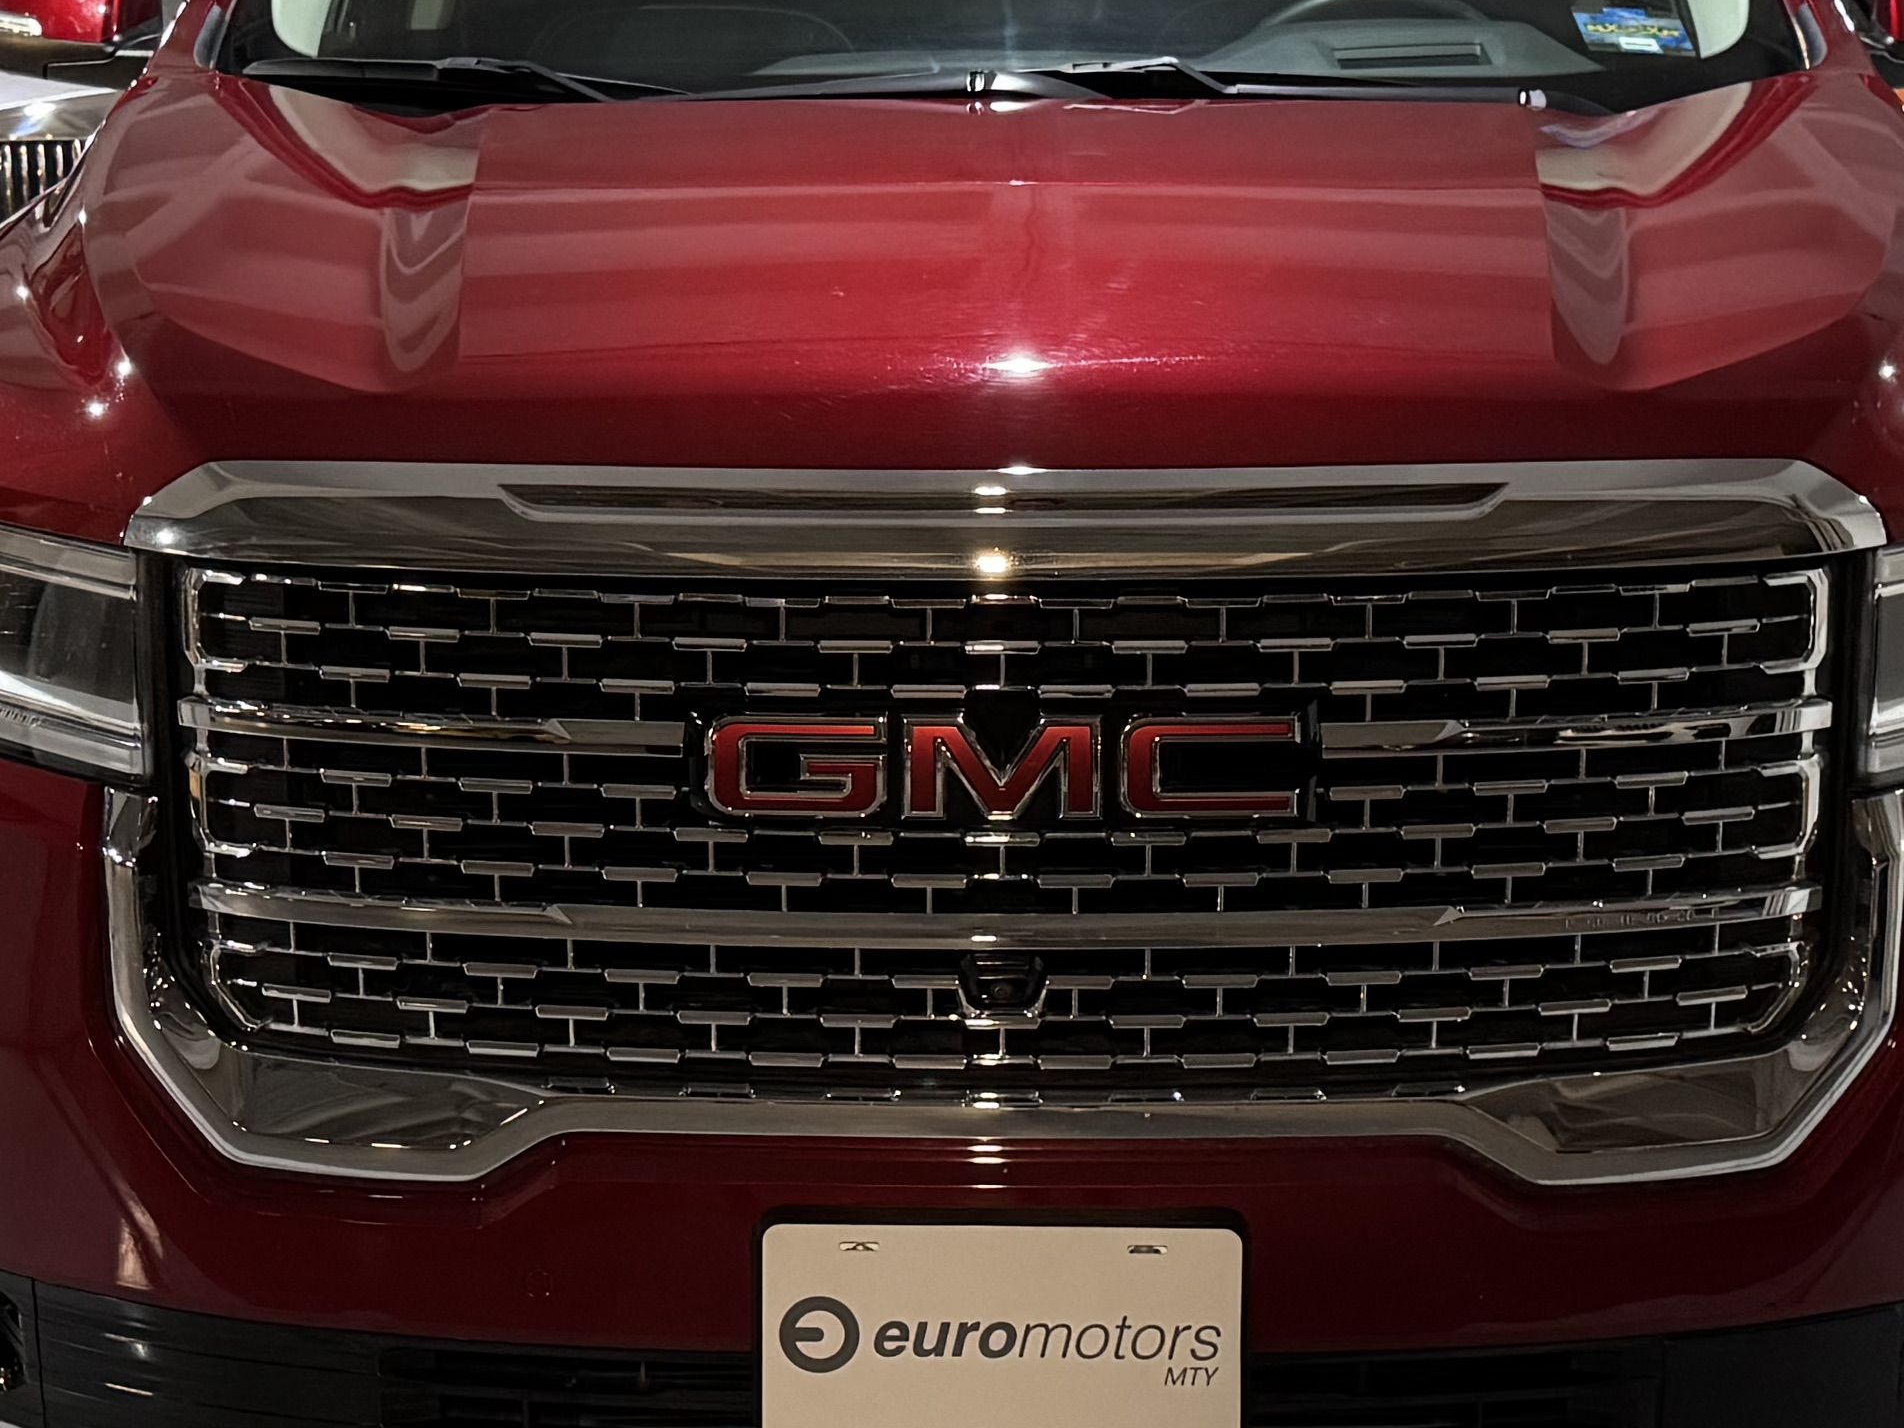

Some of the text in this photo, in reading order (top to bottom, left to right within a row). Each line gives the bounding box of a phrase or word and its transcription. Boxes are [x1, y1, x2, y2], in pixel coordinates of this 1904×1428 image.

[706, 714, 1298, 820] GMC
[872, 1314, 1223, 1361] euromotors
[1163, 1366, 1220, 1387] MTY
